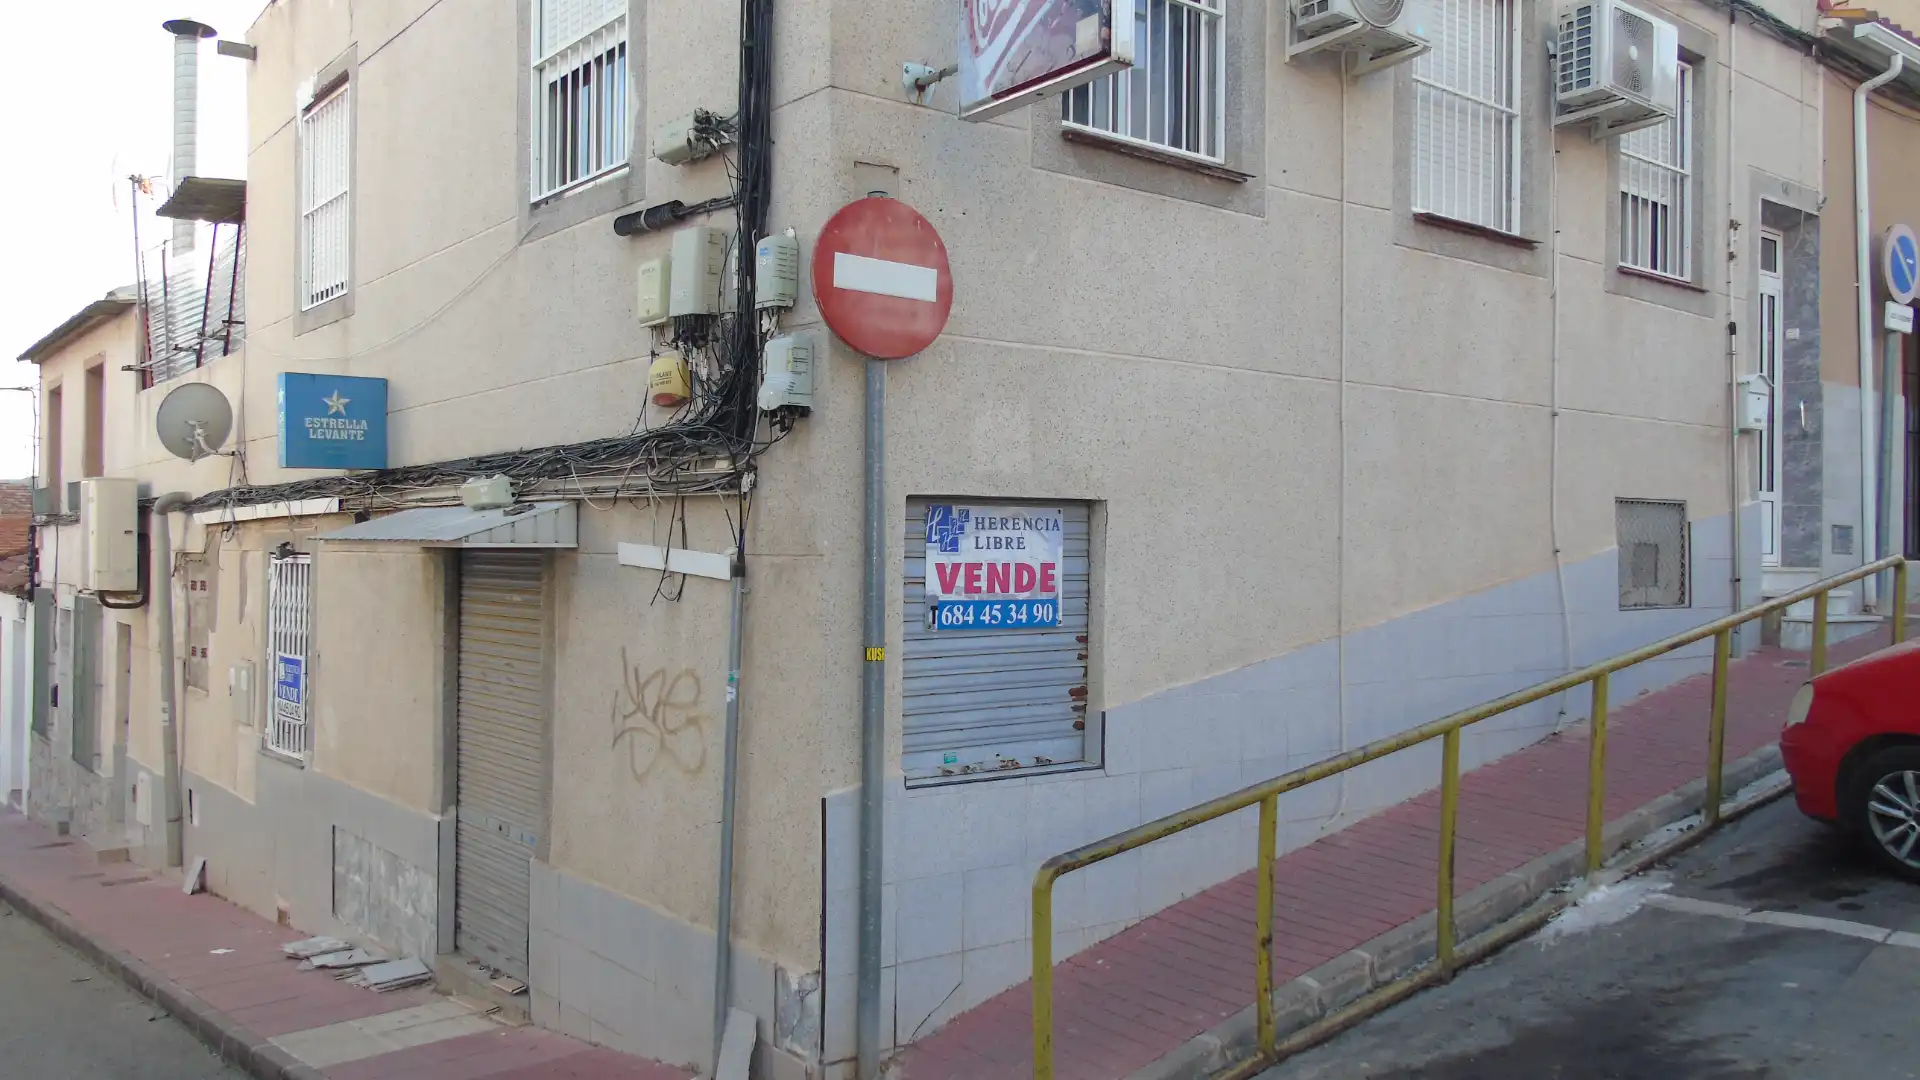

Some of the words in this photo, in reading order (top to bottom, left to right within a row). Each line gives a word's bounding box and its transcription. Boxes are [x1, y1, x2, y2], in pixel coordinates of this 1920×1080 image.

[304, 417, 368, 430] ESTRELLA
[309, 428, 365, 441] LEVANTE
[974, 516, 1060, 532] HERENCIA
[974, 536, 1026, 550] LIBRE
[935, 562, 1056, 595] VENDE
[941, 604, 975, 626] 684
[980, 604, 1002, 625] 45
[1006, 603, 1028, 625] 34
[1032, 603, 1053, 623] 90
